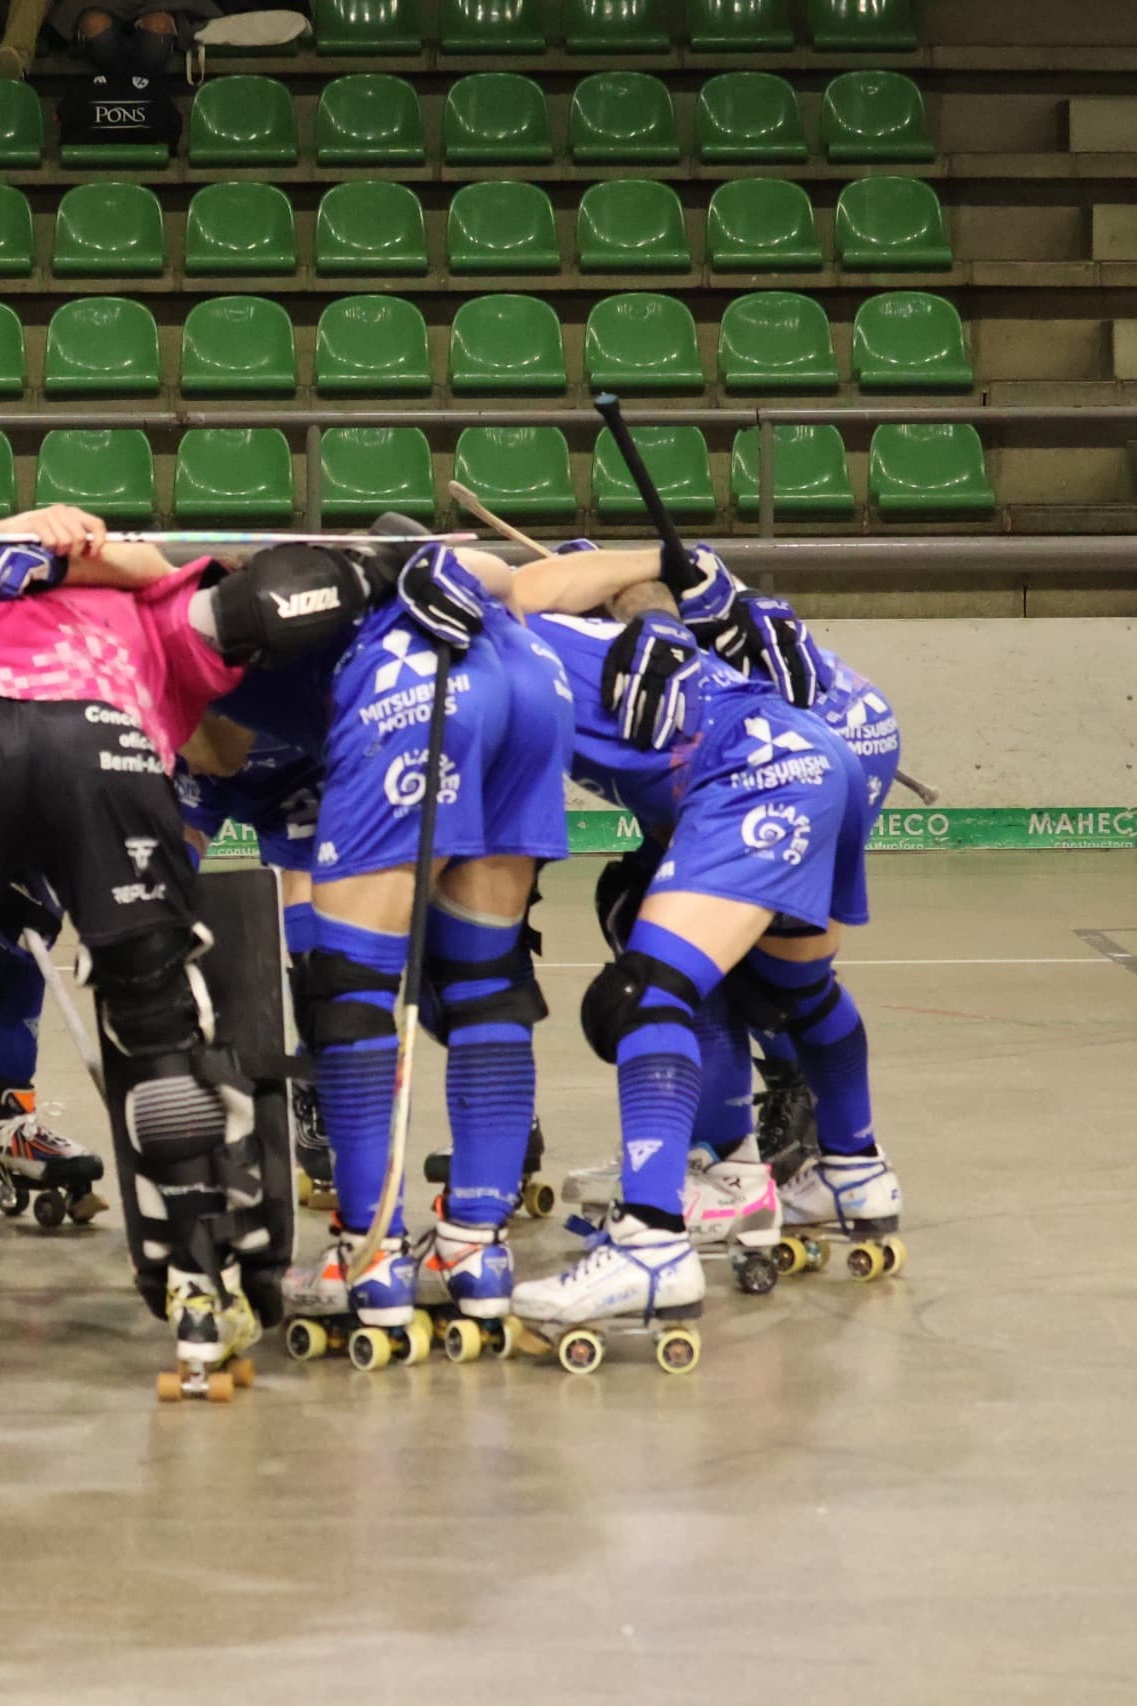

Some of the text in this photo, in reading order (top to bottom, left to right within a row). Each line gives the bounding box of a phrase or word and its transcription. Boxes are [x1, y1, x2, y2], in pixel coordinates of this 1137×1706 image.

[94, 106, 146, 123] PONS
[359, 673, 470, 725] MITSUBIHI
[378, 696, 459, 736] MOTOS
[1028, 811, 1137, 837] MAHEC
